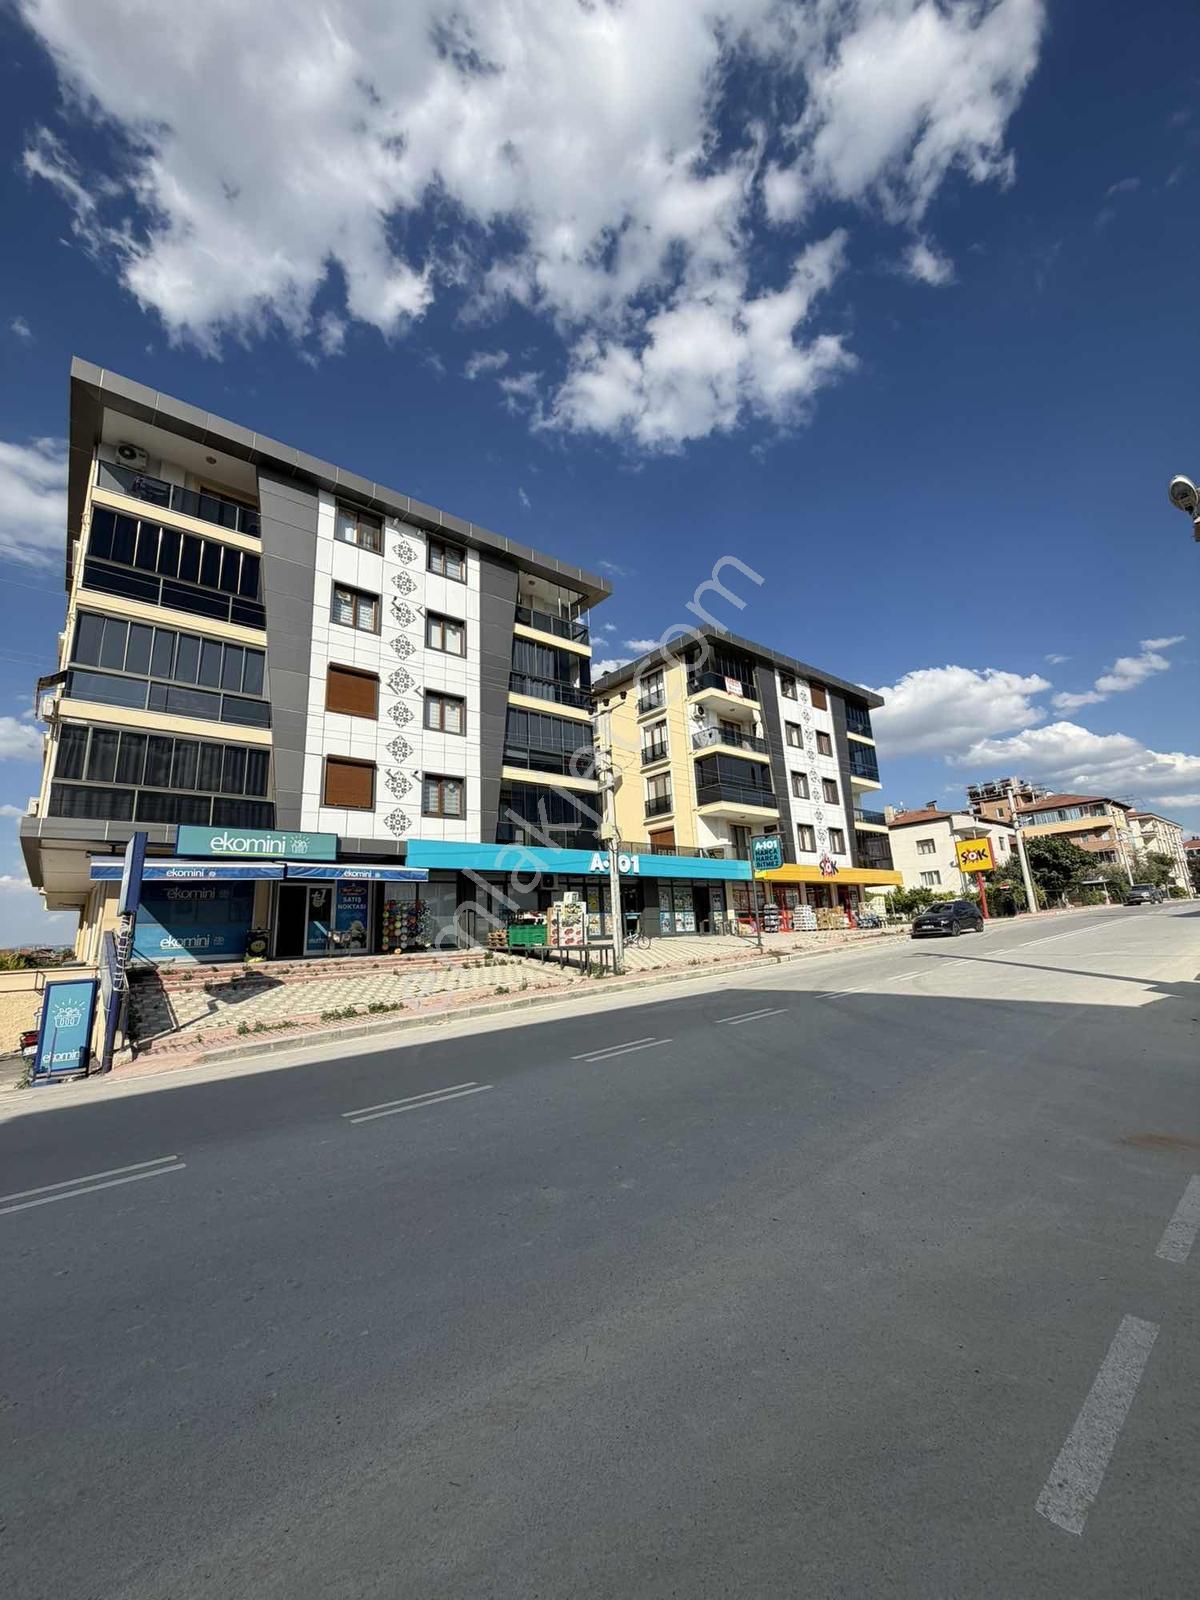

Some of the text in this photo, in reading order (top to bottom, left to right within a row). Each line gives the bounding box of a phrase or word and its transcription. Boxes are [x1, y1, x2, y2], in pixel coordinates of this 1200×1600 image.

[210, 835, 286, 854] ekomini
[166, 868, 205, 878] ekomini
[343, 869, 372, 878] ekomini
[160, 934, 210, 949] ekomini
